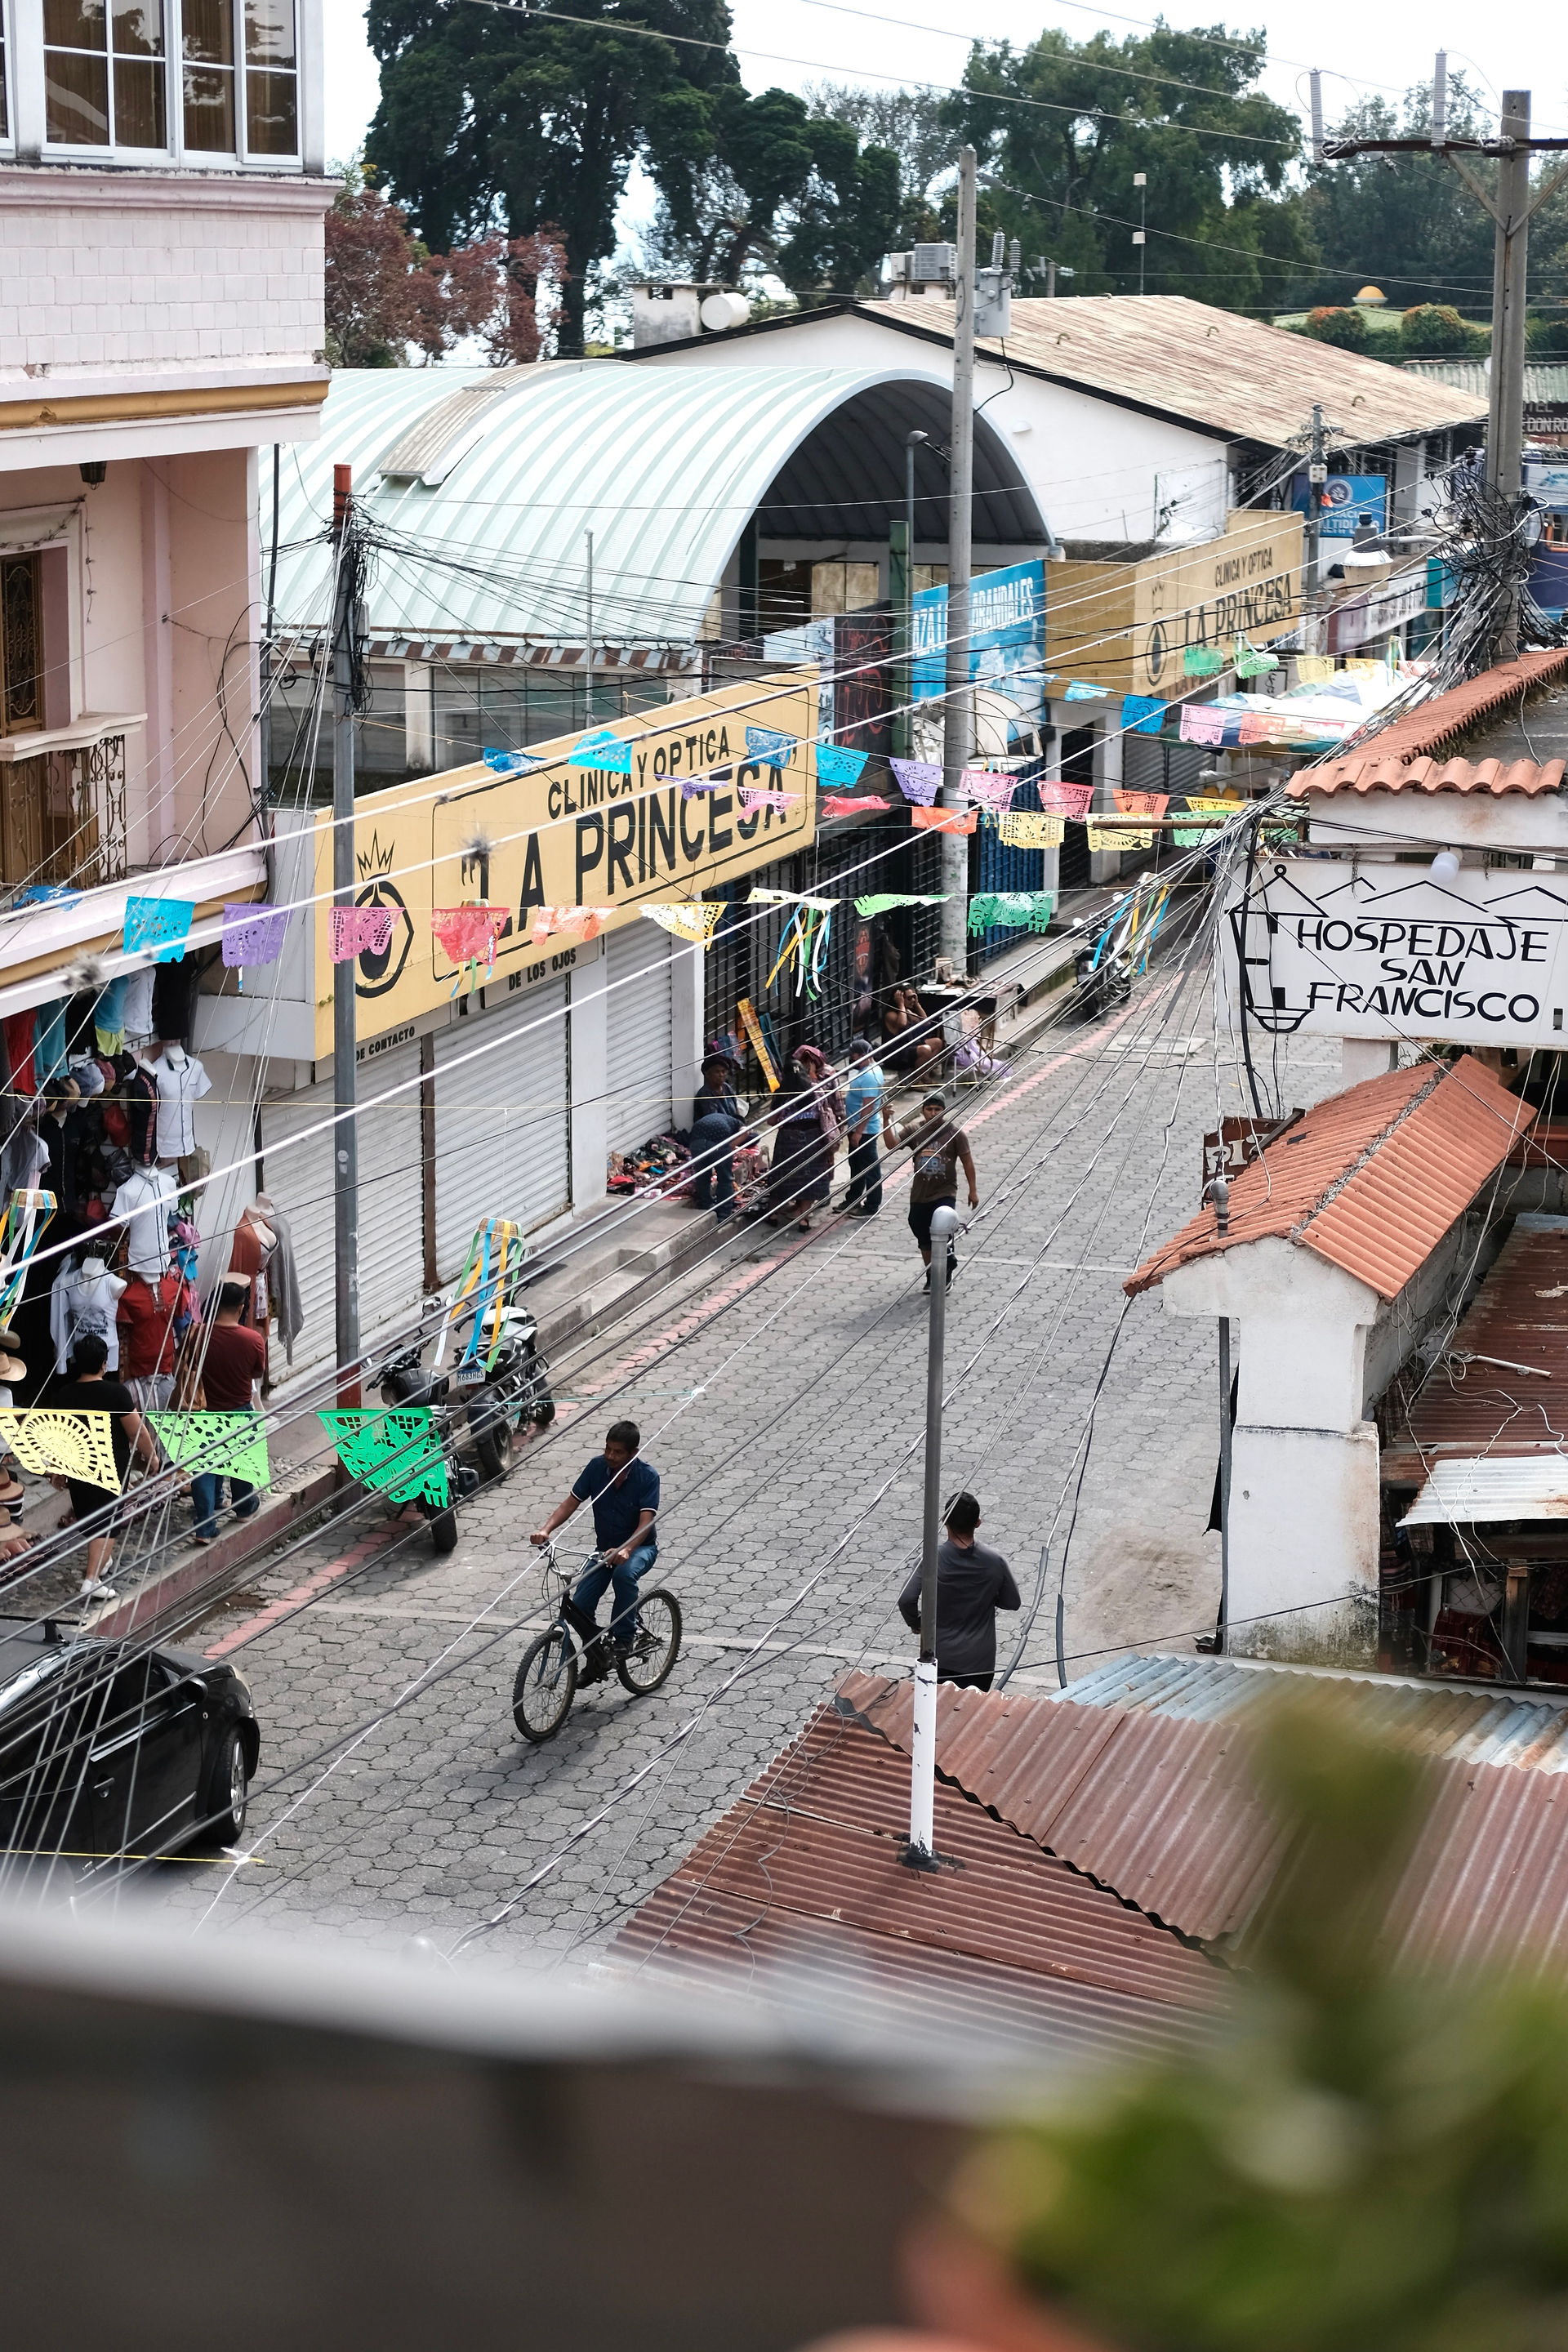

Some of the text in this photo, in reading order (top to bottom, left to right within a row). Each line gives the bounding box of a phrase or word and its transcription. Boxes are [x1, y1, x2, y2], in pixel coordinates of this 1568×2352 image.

[1215, 547, 1272, 588] CLINICA Y OPTICA
[969, 577, 1034, 639] ARANDALES
[1214, 573, 1292, 646] PRINCESA
[548, 725, 730, 820] CLINICA Y OPTICA
[1298, 918, 1549, 963] HOSPEDAJE
[509, 947, 577, 991] DE LOS OJOS
[1379, 959, 1466, 987] SAN
[1307, 982, 1540, 1023] FRANCISCO
[368, 1026, 415, 1055] CONTACTO
